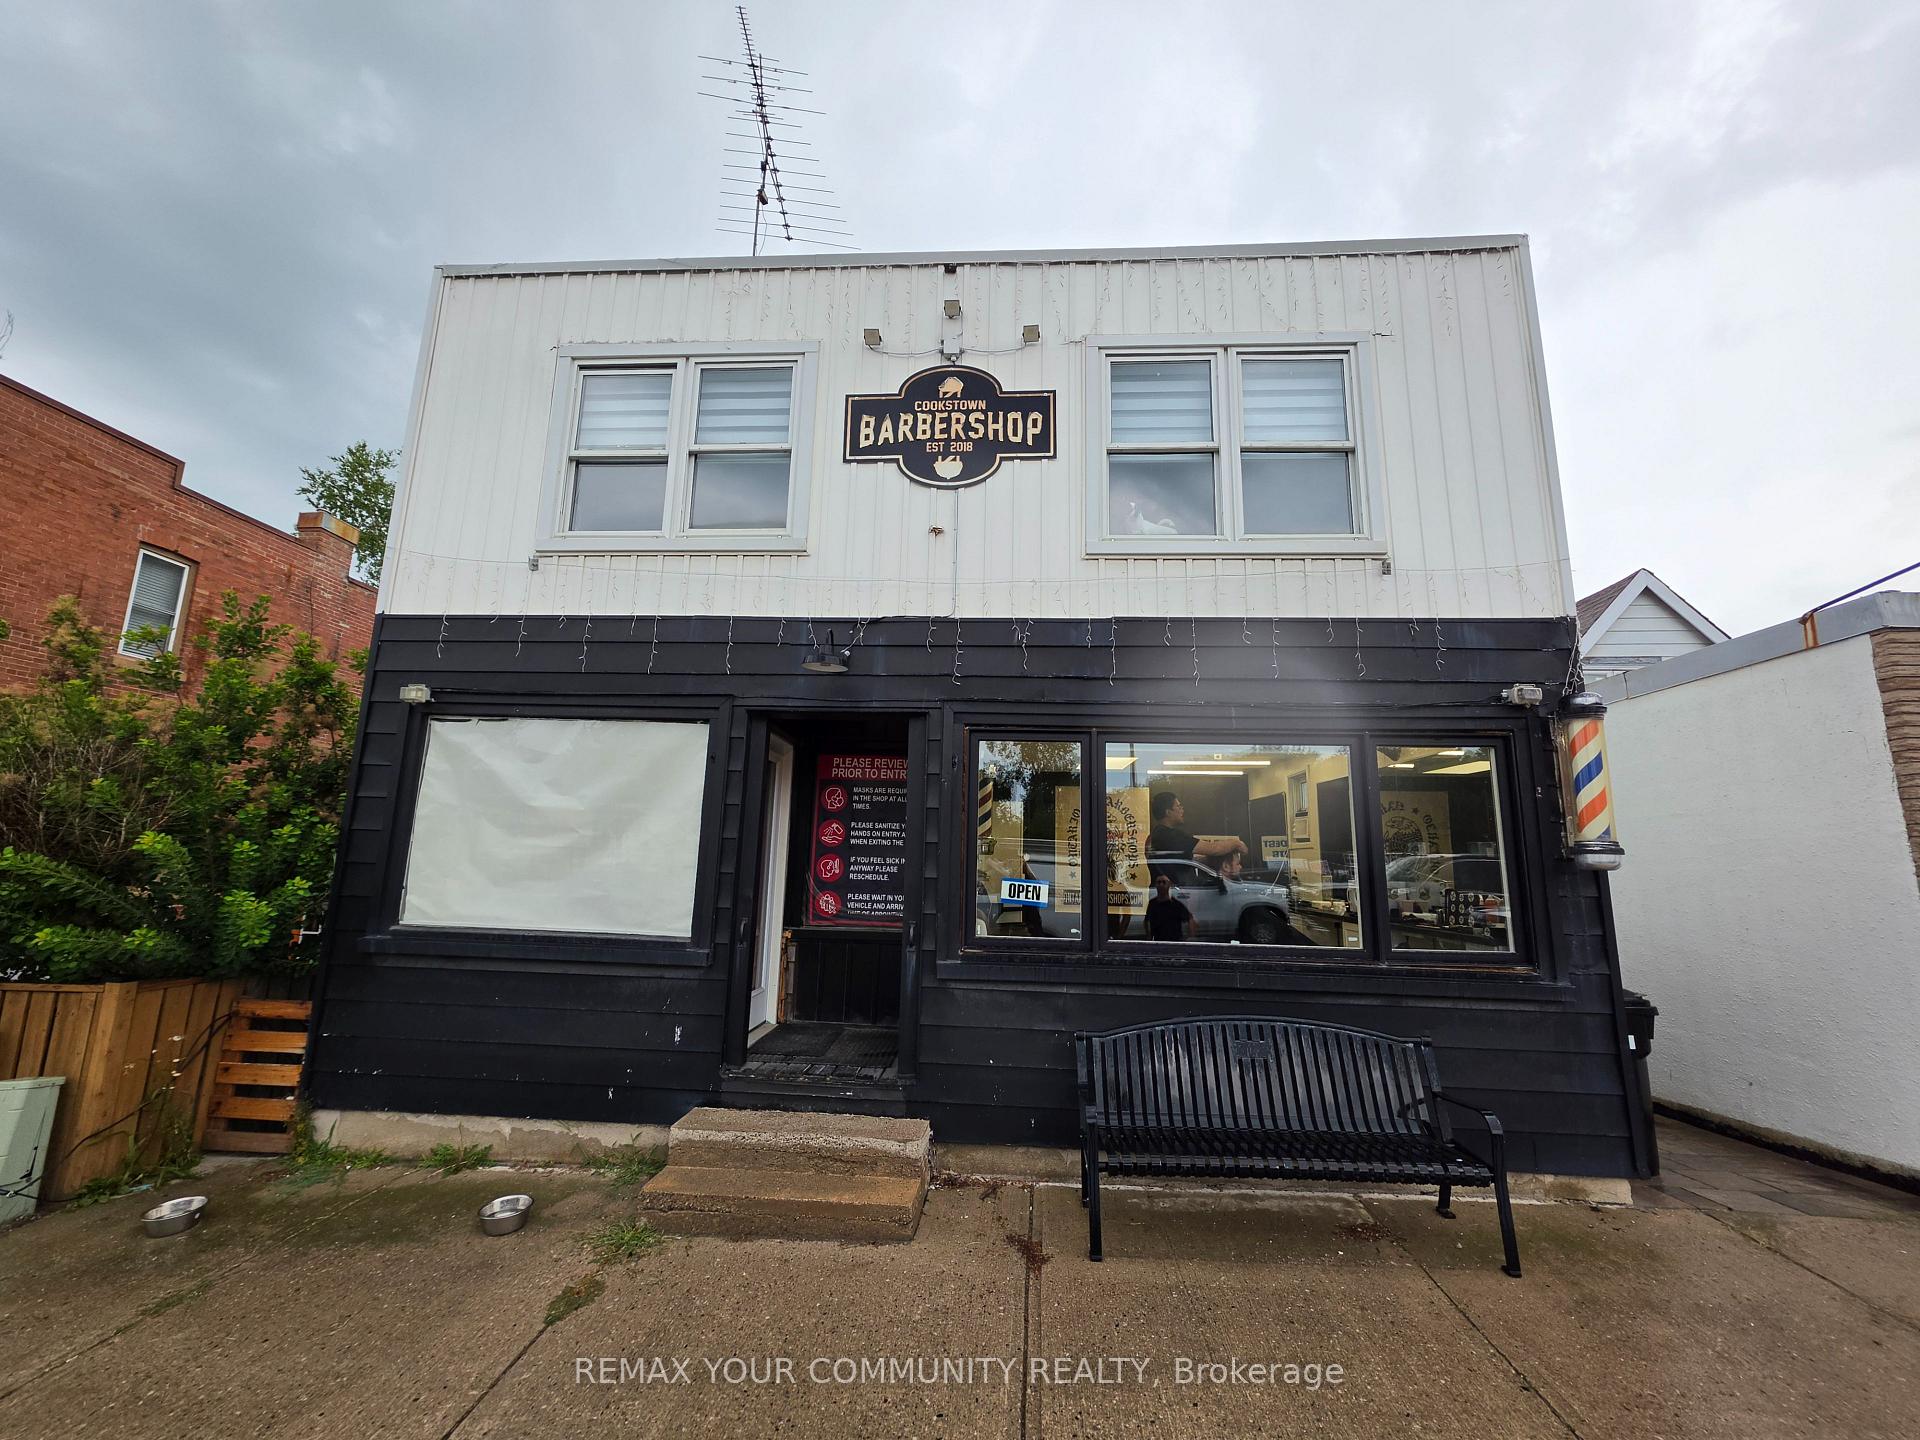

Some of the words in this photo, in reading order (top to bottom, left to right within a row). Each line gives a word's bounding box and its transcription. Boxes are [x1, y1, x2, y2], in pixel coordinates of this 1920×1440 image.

[914, 400, 987, 411] COOKSTOWN
[859, 411, 1043, 449] BARBERSHOP
[926, 442, 945, 453] EST
[950, 441, 973, 452] 2018
[833, 757, 872, 768] PLEASE
[831, 768, 862, 778] PRIOR
[865, 768, 878, 778] TO
[880, 769, 908, 779] ENTR
[850, 821, 874, 829] PLEASE
[874, 822, 901, 830] SANITIZE
[1105, 795, 1140, 869] ARBERSHOPS
[870, 856, 885, 864] FEEL
[875, 865, 898, 873] PLEASE
[1008, 882, 1042, 901] OPEN
[847, 901, 872, 909] VEHICLE
